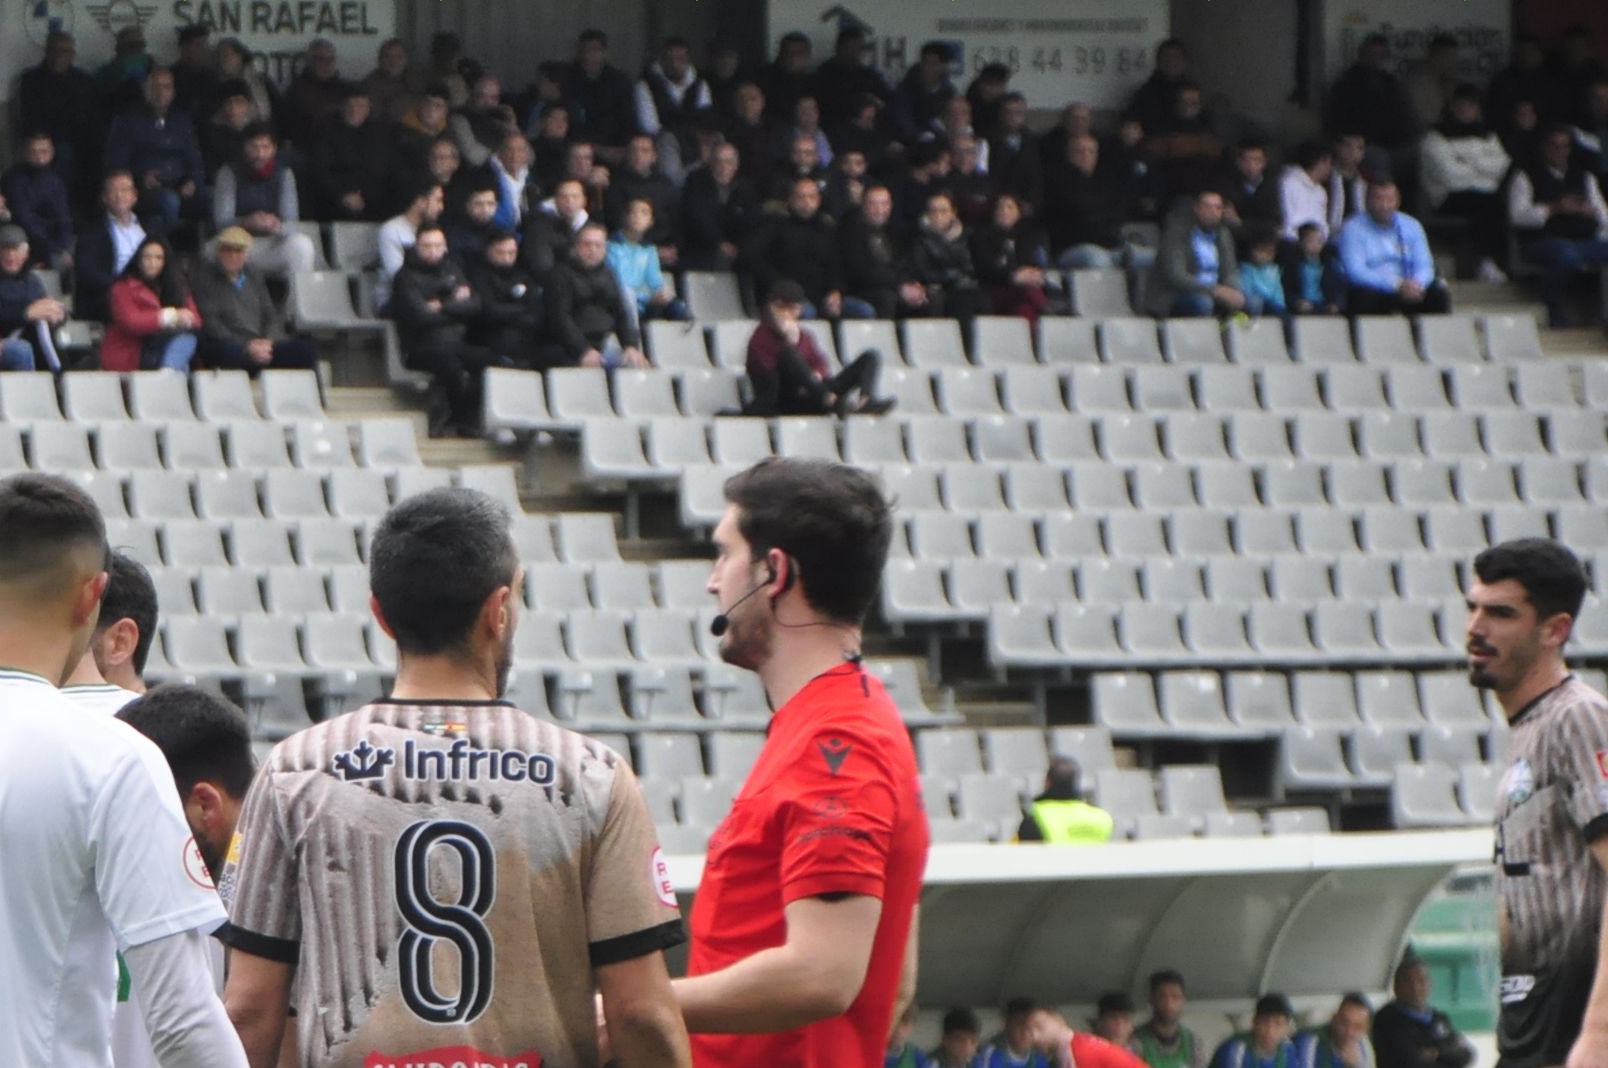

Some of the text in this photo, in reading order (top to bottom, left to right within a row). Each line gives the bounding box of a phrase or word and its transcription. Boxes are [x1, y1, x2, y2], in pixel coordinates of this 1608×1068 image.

[251, 0, 378, 36] RAFAEL
[404, 738, 556, 786] Infrico
[394, 818, 498, 1027] 8
